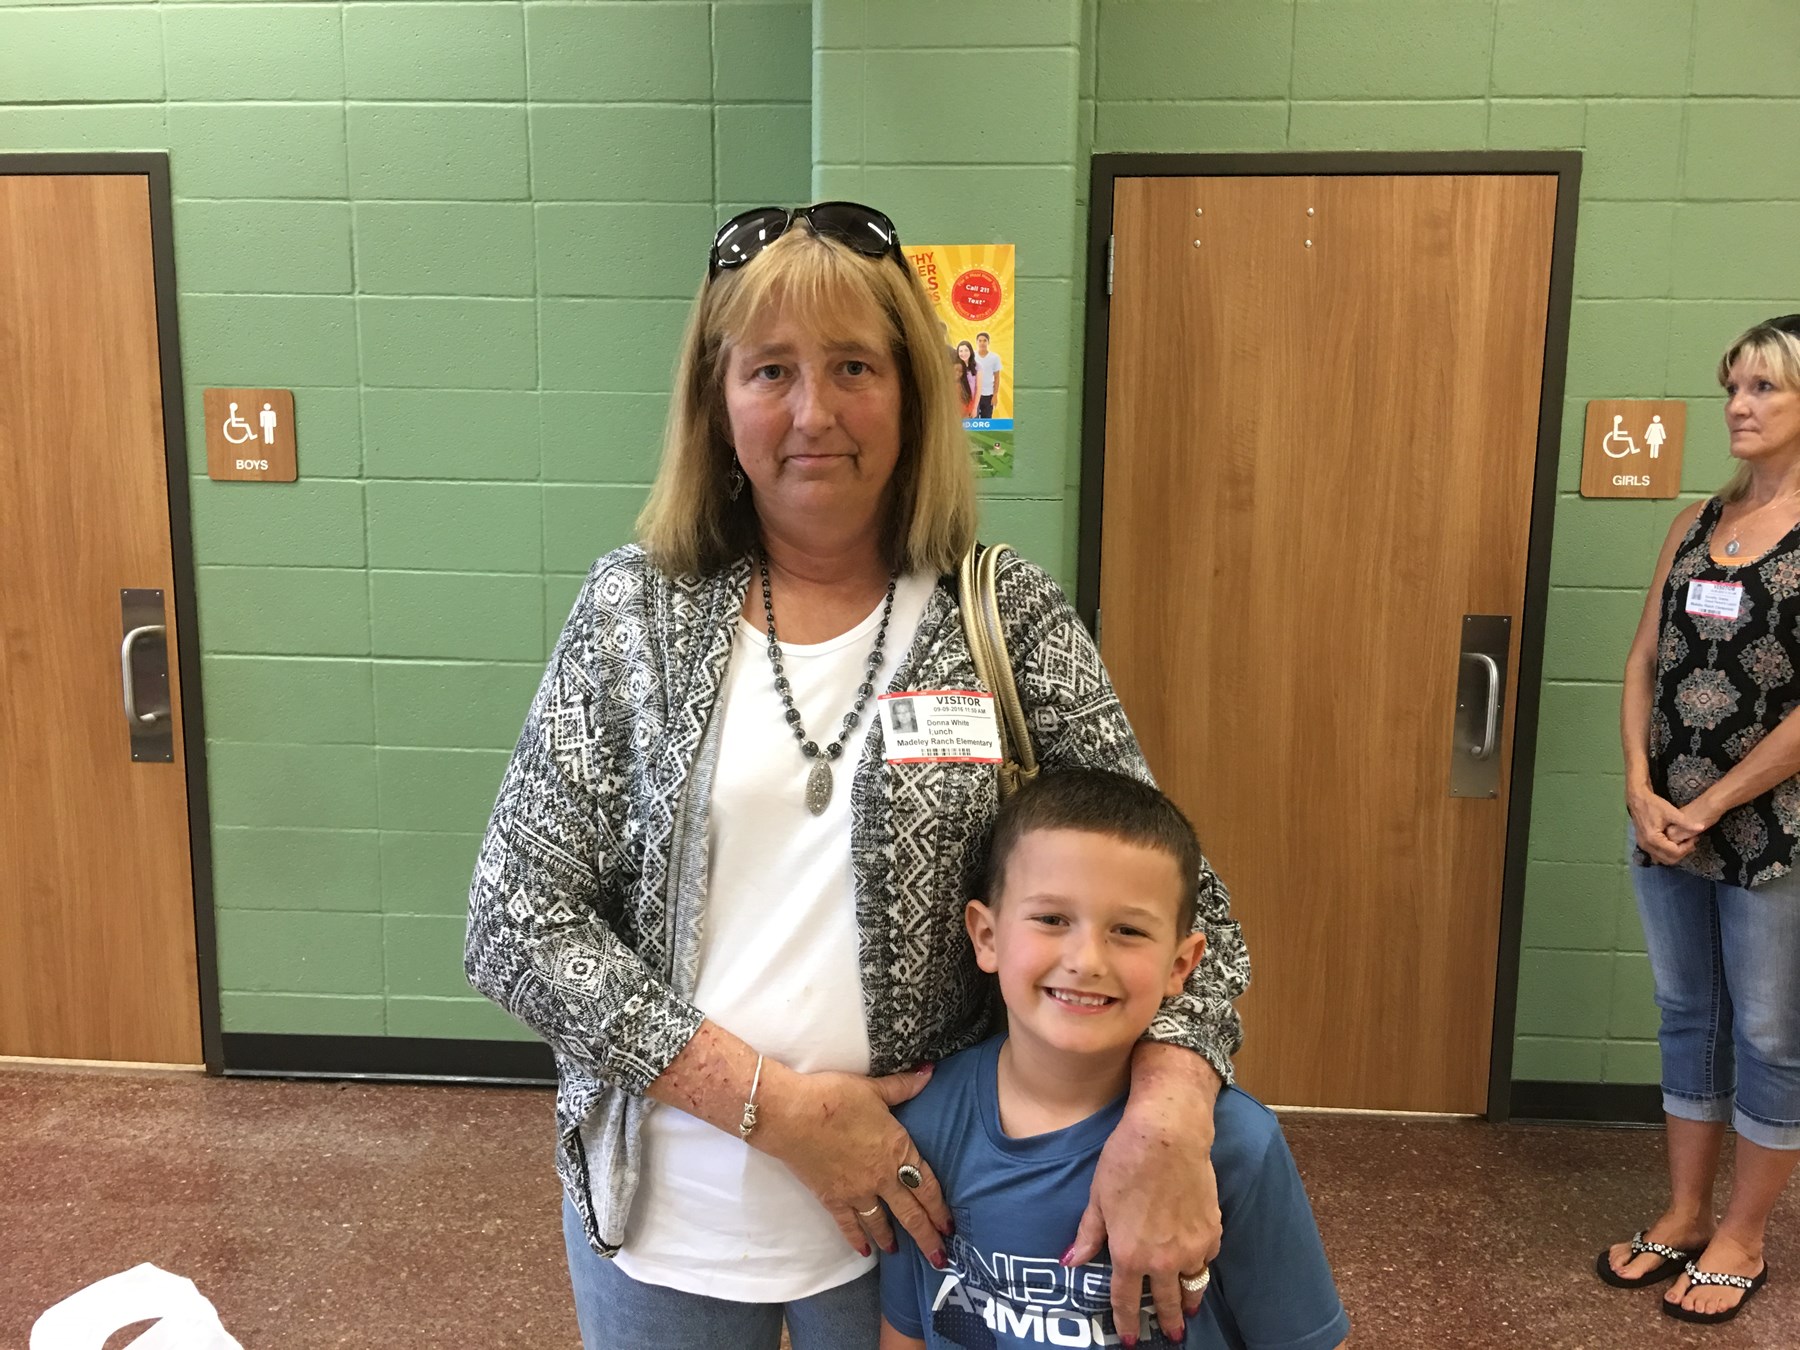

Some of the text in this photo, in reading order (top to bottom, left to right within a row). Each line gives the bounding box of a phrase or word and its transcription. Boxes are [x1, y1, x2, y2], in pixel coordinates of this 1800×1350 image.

[965, 284, 979, 292] Call
[979, 286, 990, 294] 211
[236, 459, 268, 470] BOYS
[1612, 475, 1650, 486] GIRLS
[936, 696, 981, 707] VISITOR
[926, 719, 970, 727] Donna White
[897, 737, 993, 748] Madeley Ranch Elementary
[932, 1234, 1153, 1312] NDE
[932, 1275, 1158, 1348] ARMOU
